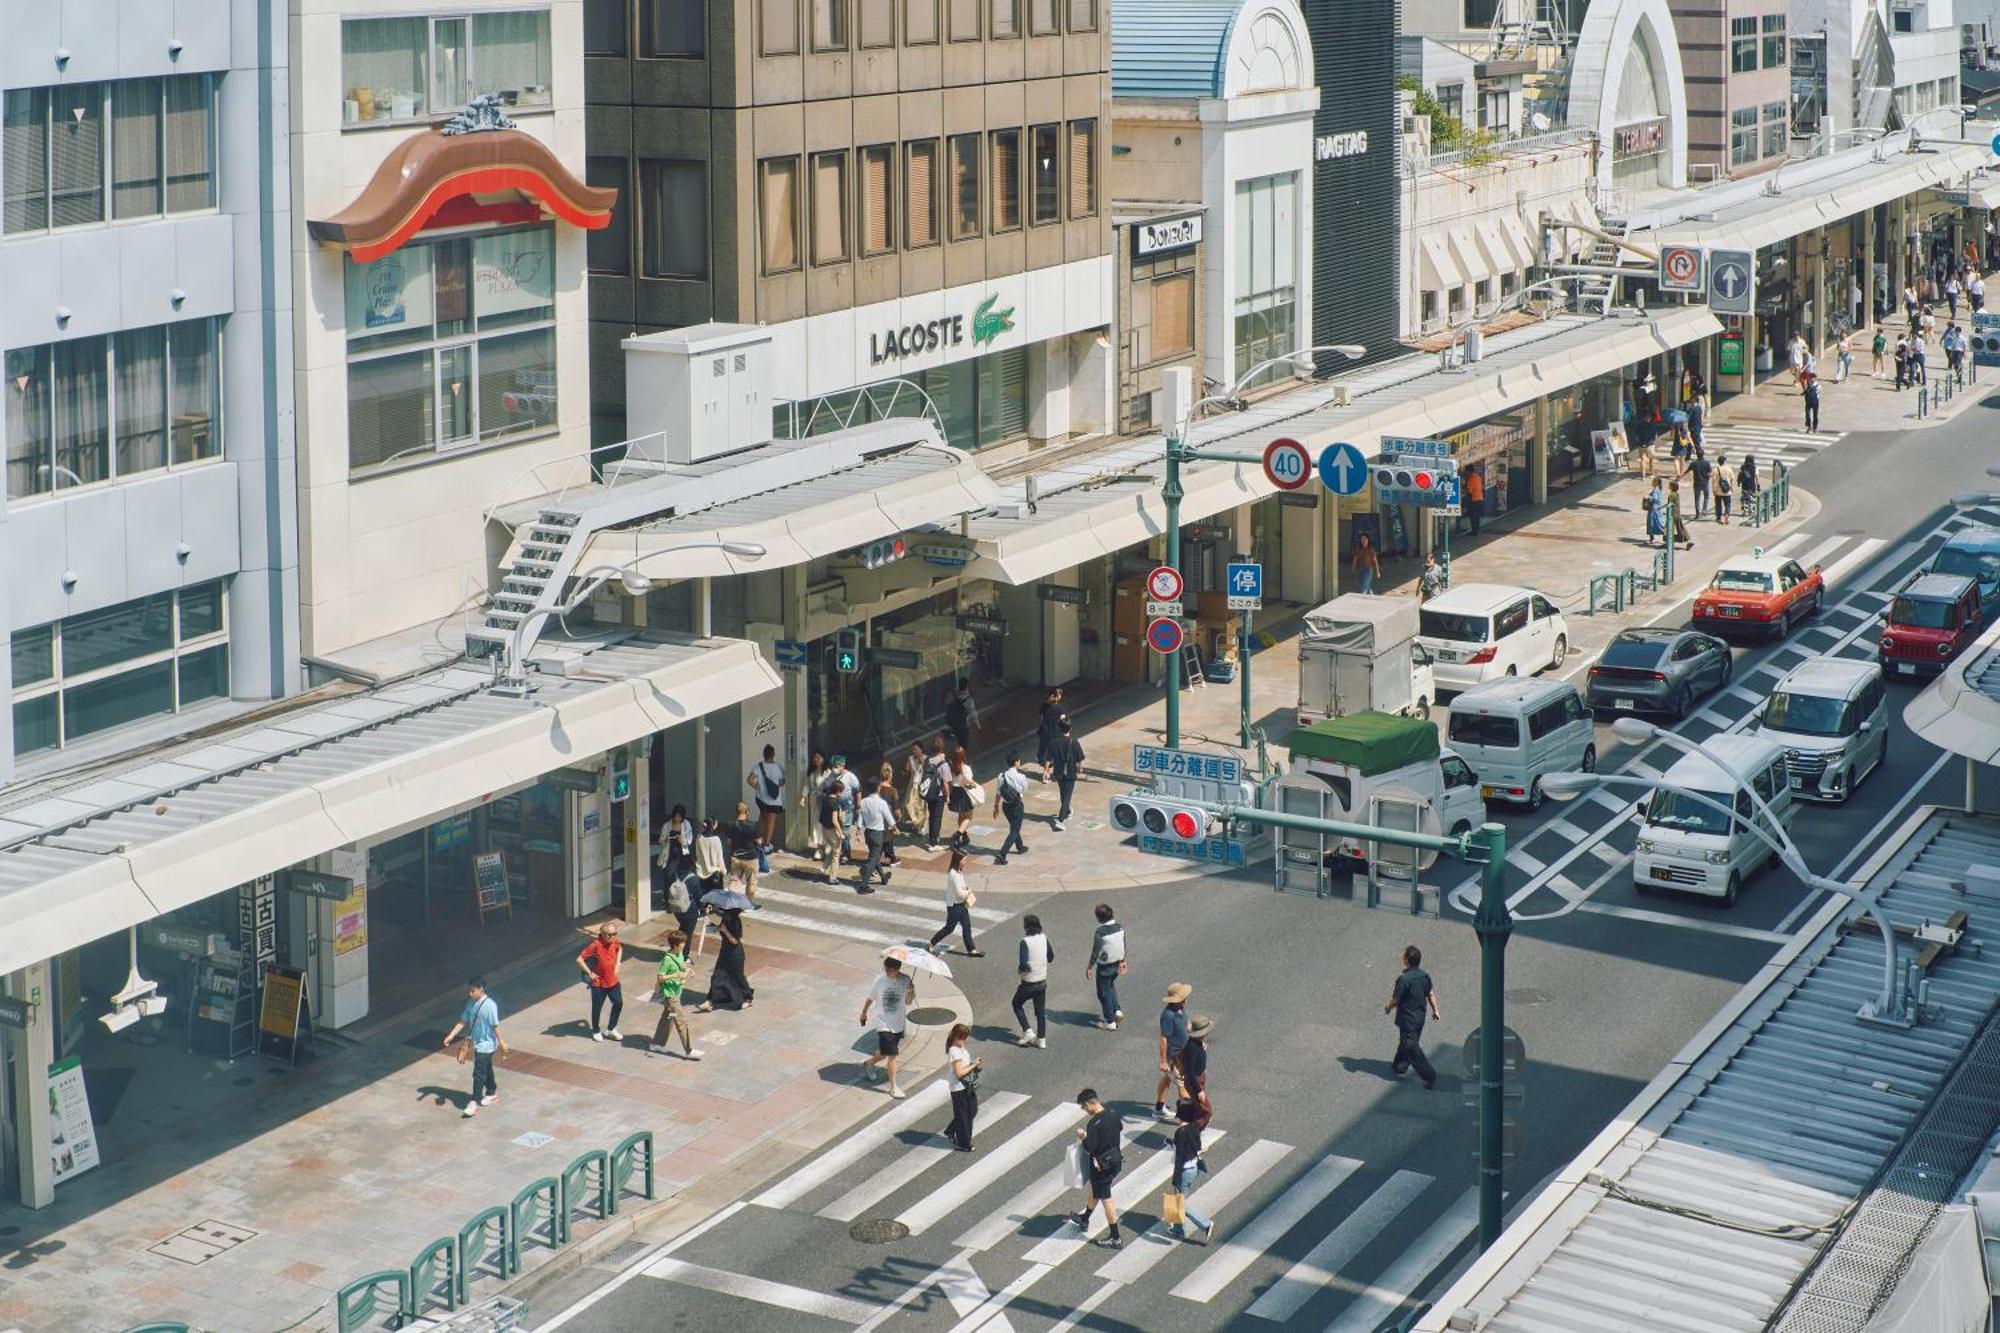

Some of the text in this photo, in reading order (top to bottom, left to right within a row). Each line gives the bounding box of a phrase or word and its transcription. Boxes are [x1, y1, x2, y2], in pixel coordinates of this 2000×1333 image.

[1315, 131, 1367, 161] RAGTAG
[871, 314, 963, 366] LACOSTE
[1384, 440, 1446, 456] 歩車分離信号
[1275, 453, 1299, 475] 40
[1233, 570, 1257, 592] 停
[1138, 749, 1236, 780] 歩車分離信号
